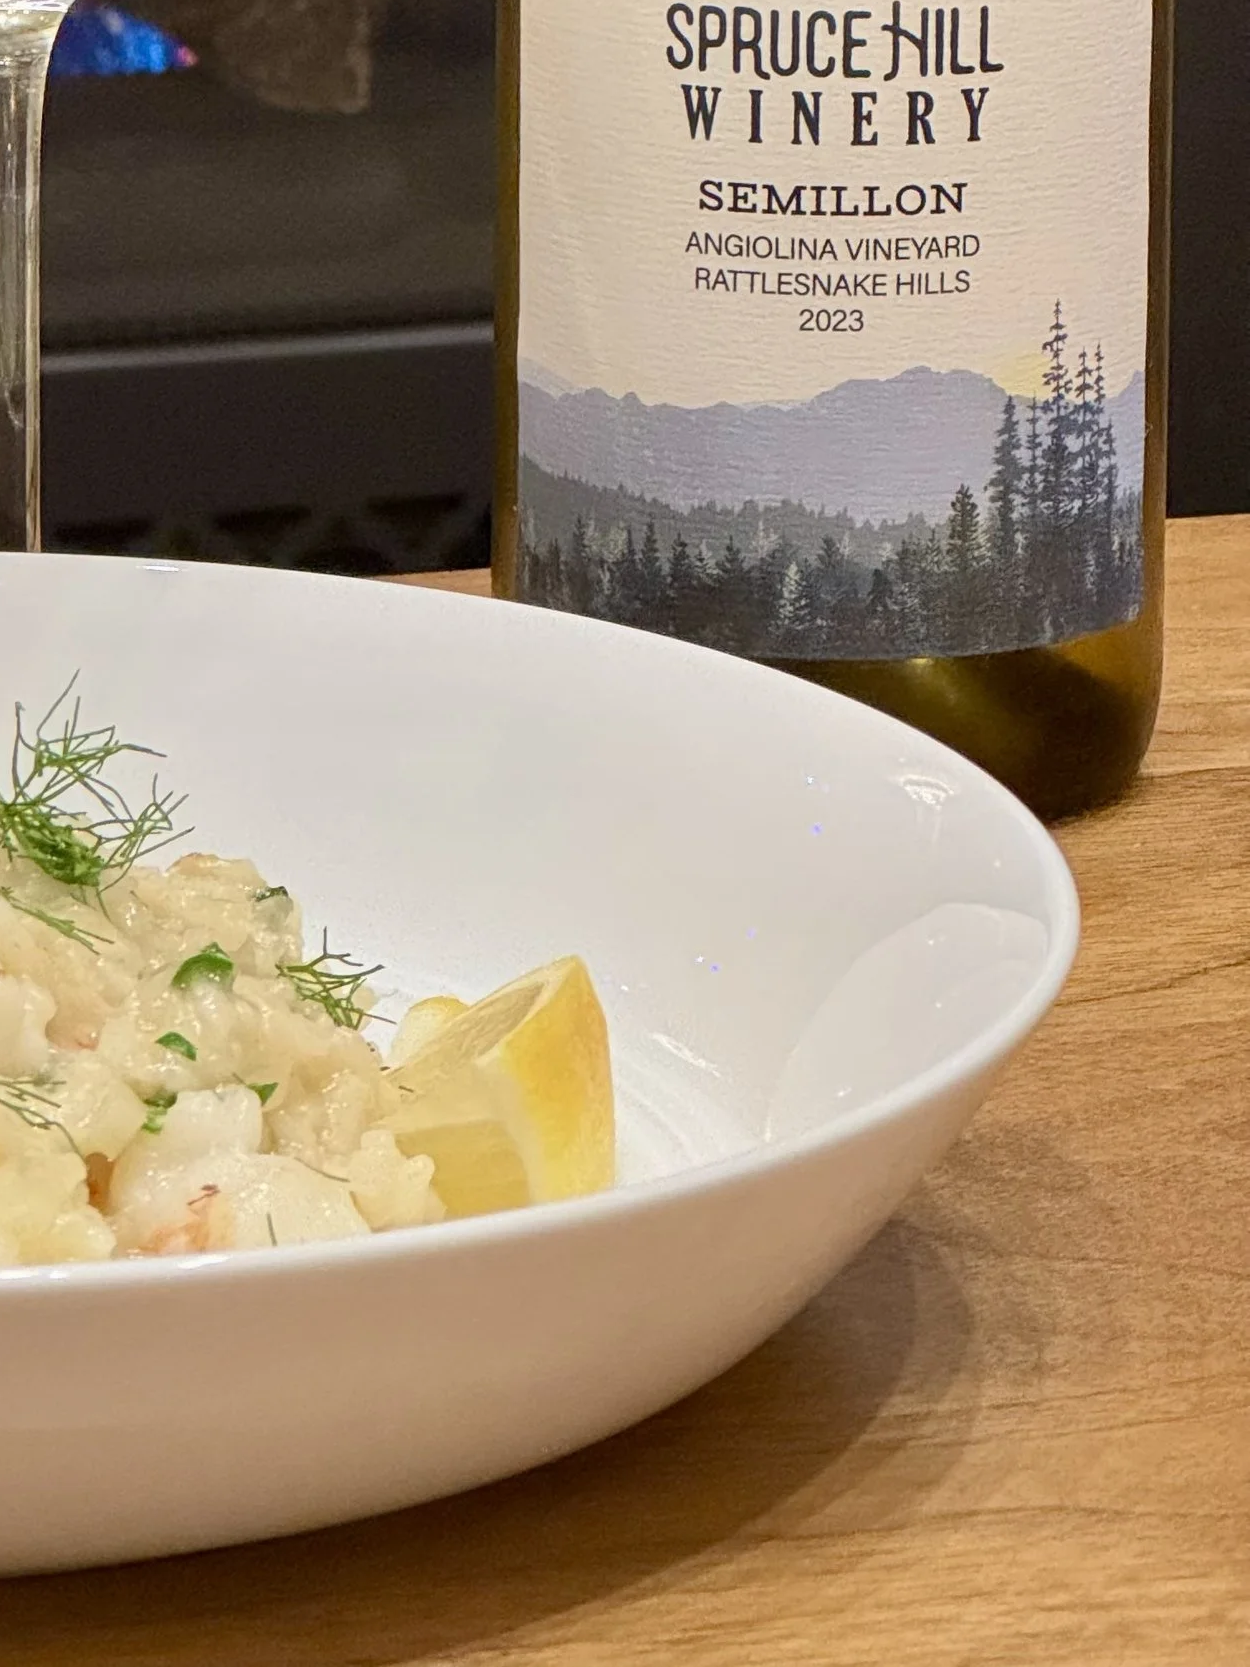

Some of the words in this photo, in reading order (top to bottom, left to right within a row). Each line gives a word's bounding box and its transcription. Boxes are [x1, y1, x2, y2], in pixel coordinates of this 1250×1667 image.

[666, 3, 871, 80] SPRUCE
[881, 0, 1004, 81] HILL
[681, 84, 989, 146] WINERY
[699, 179, 968, 216] SEMILLON
[685, 231, 838, 261] ANGIOLINA
[845, 234, 980, 261] VINEYARD
[695, 267, 887, 297] RATTLESNAKE
[896, 270, 970, 295] HILLS
[799, 309, 864, 332] 2023
